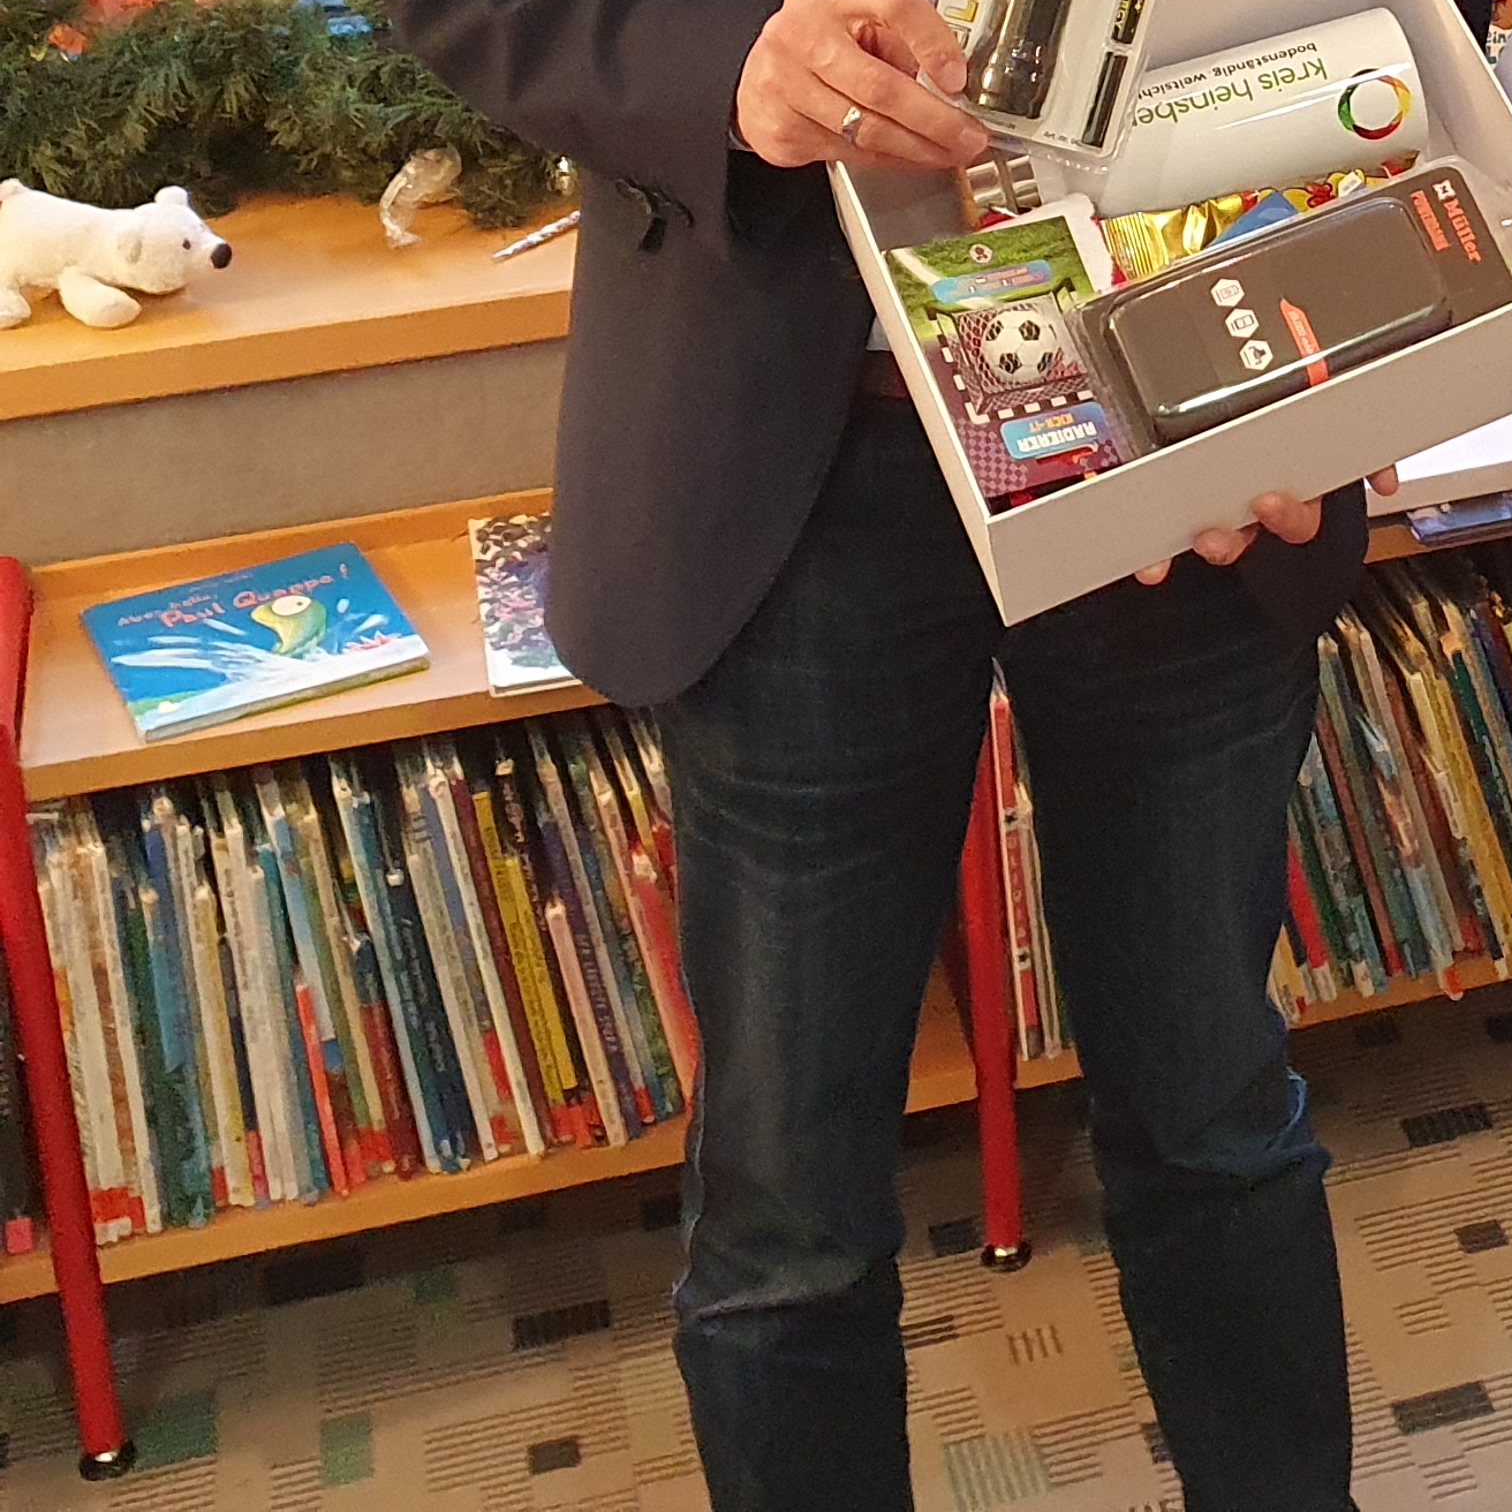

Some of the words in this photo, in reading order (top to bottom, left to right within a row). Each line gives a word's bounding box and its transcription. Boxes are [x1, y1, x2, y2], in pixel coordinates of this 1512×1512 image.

[1257, 57, 1329, 93] kreis
[1443, 197, 1483, 263] Müller
[1016, 421, 1098, 453] RADIERER
[159, 602, 226, 628] Paul
